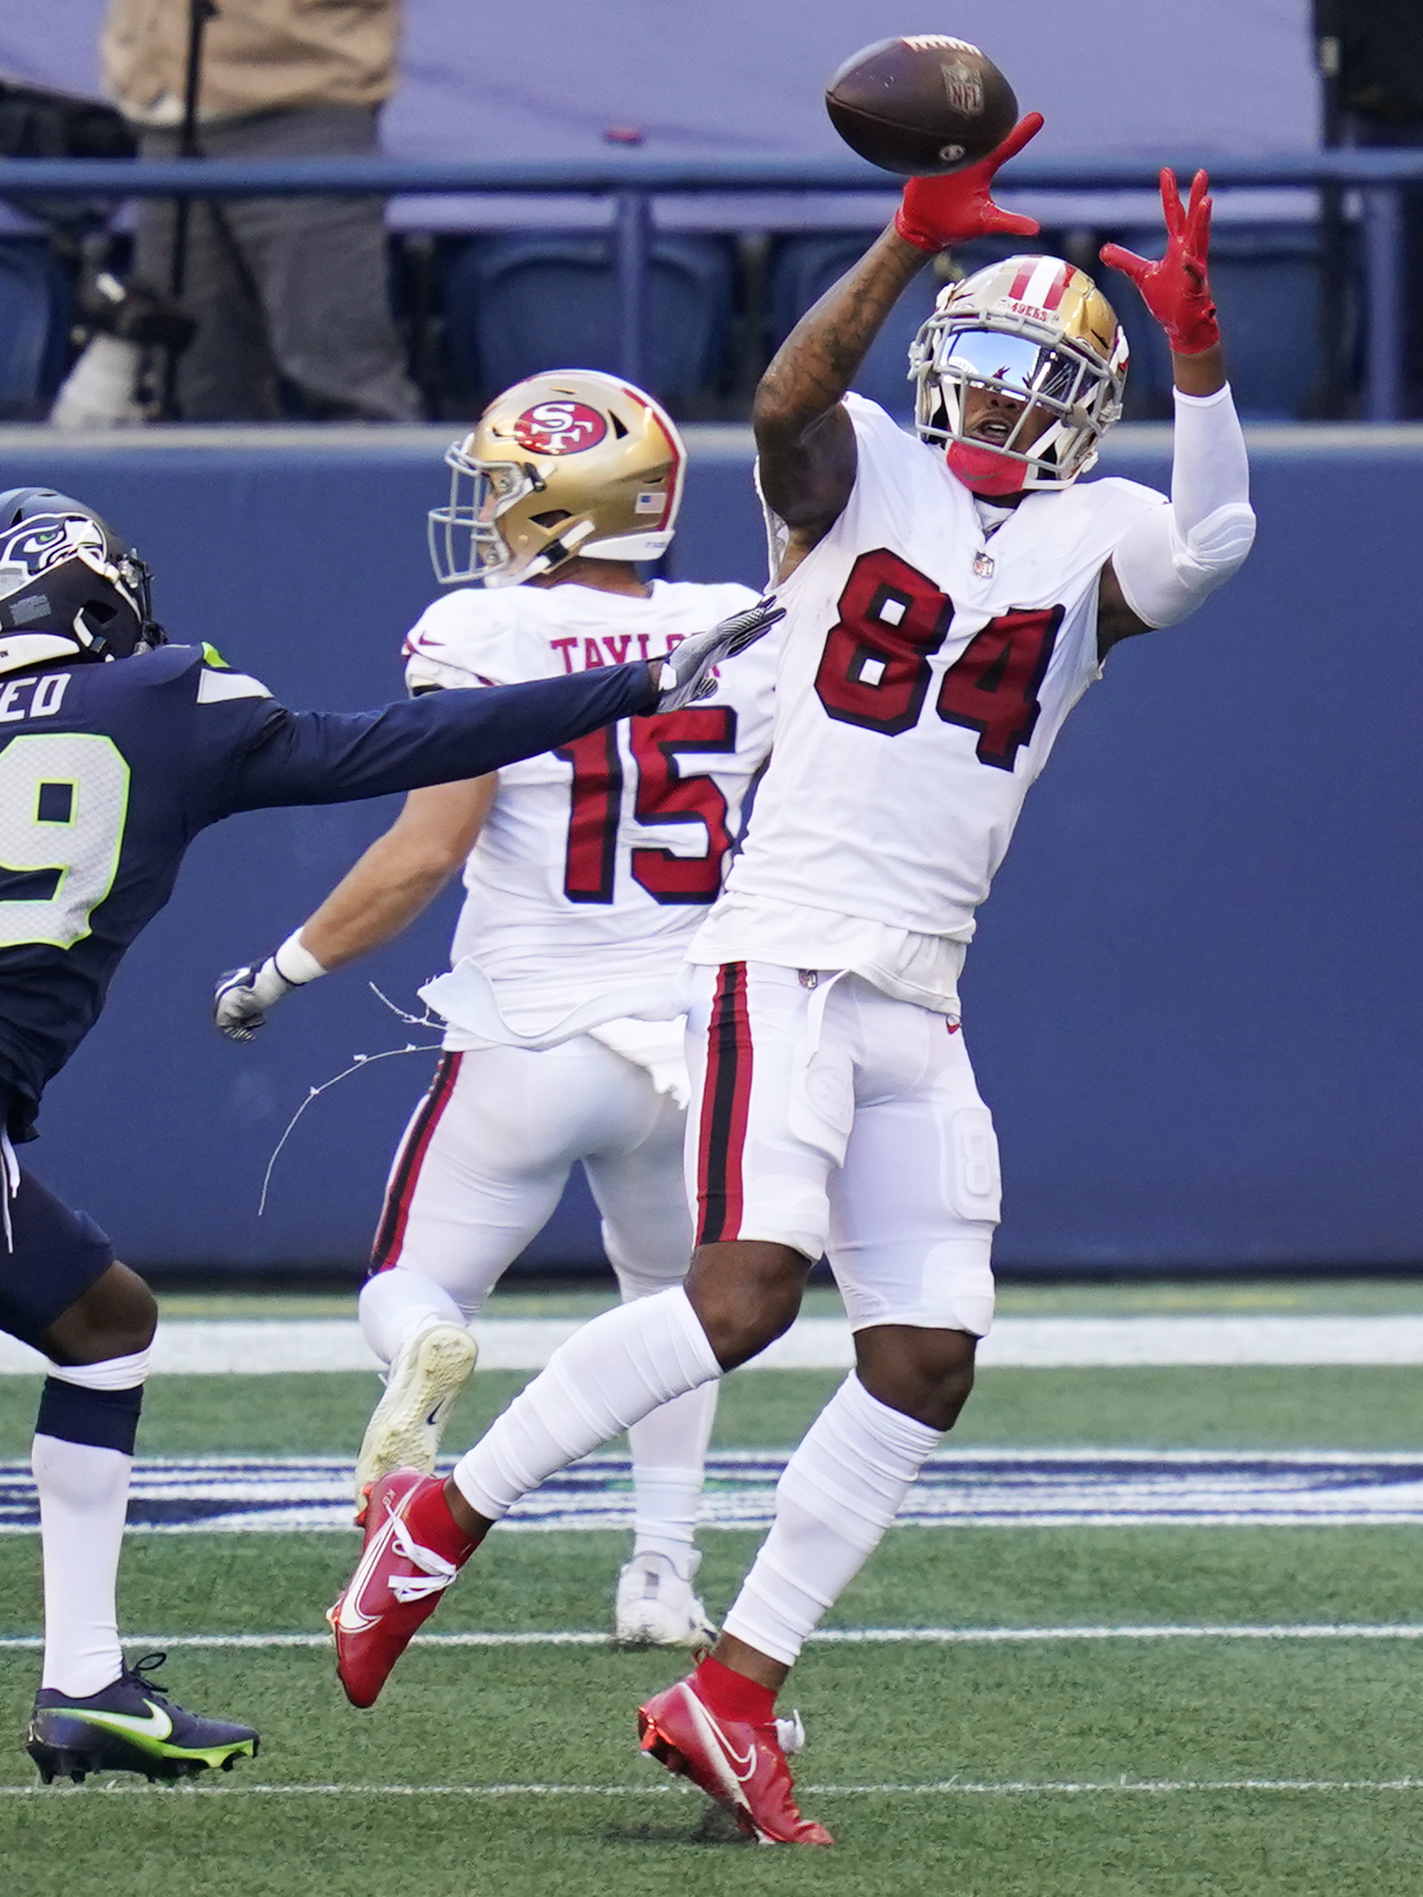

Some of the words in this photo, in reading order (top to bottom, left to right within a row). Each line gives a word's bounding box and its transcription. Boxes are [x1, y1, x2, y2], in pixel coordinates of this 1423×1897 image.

[951, 84, 978, 110] NFL
[1011, 302, 1048, 322] 49ERS
[549, 630, 722, 679] TAYL
[814, 547, 1066, 773] 84
[549, 704, 739, 906] 15
